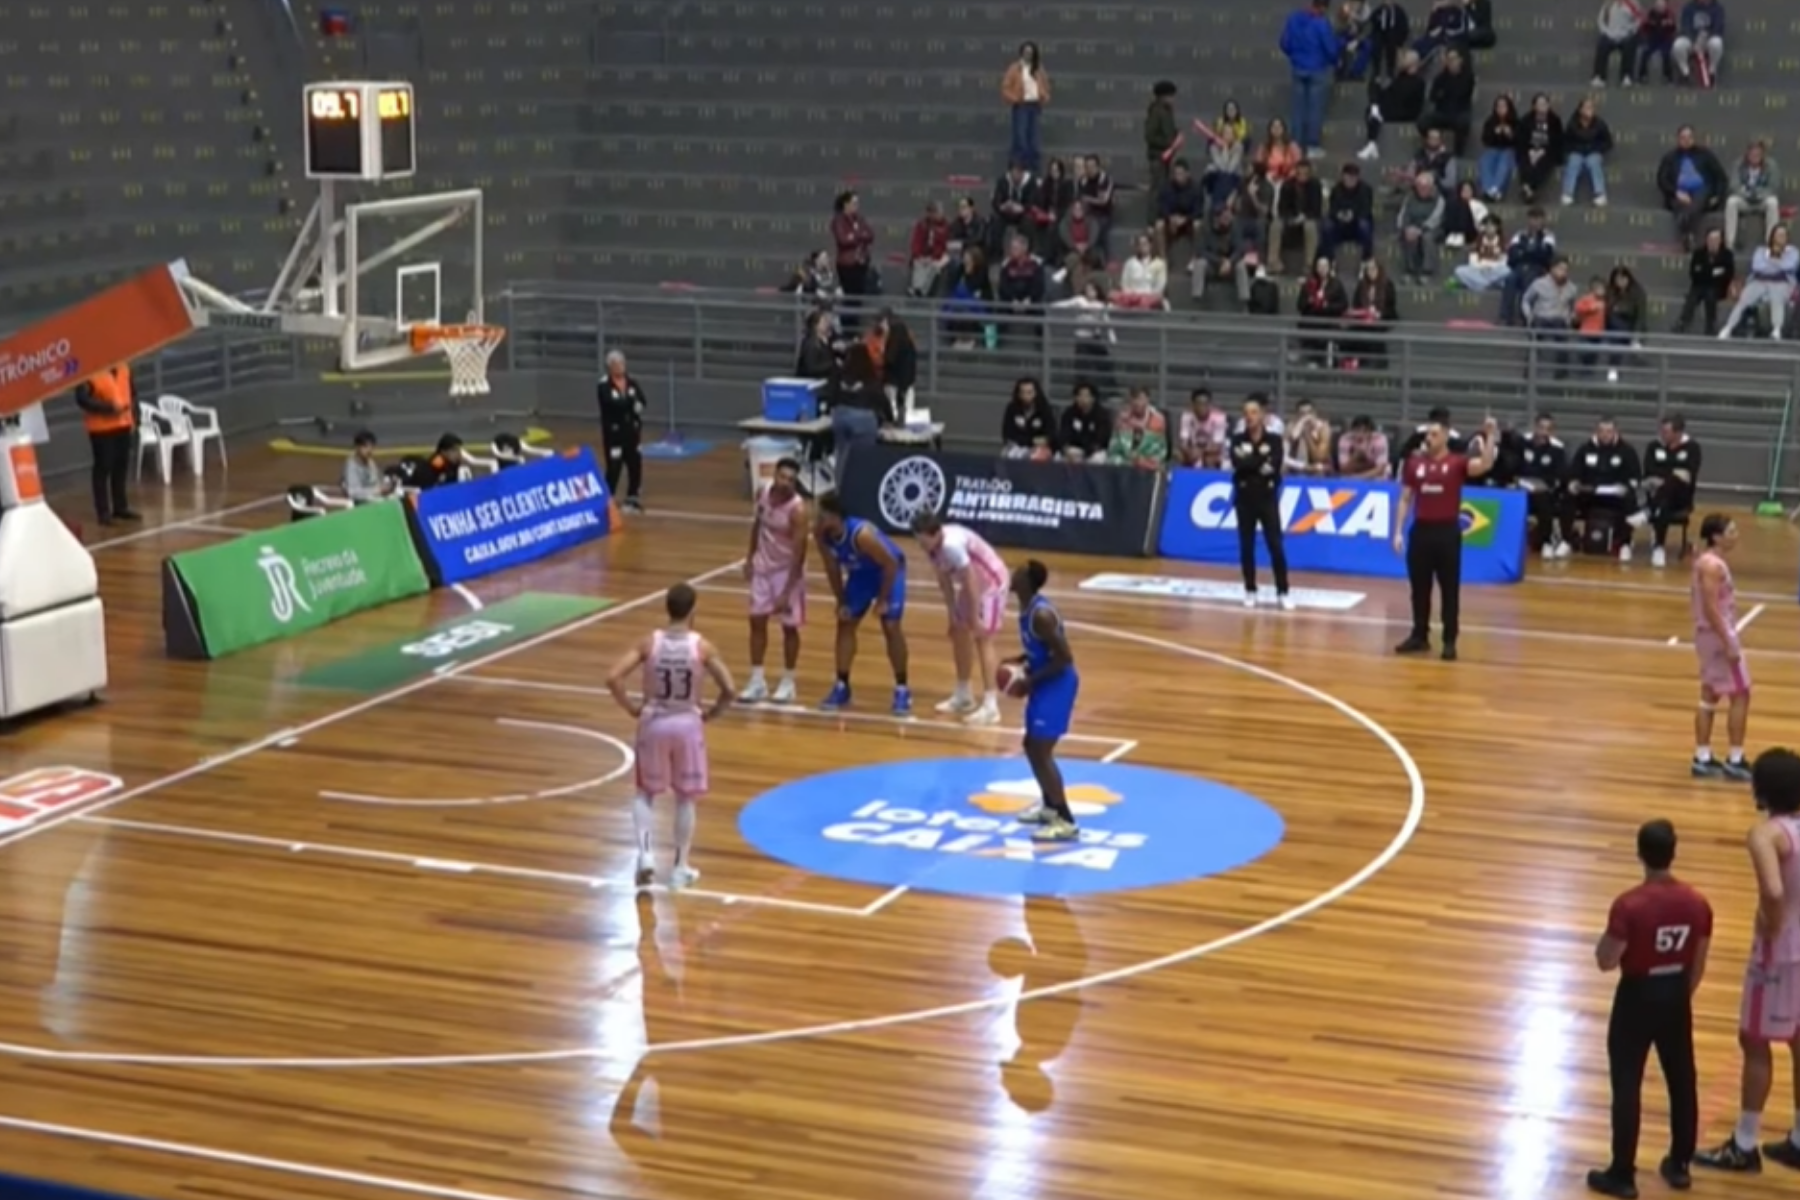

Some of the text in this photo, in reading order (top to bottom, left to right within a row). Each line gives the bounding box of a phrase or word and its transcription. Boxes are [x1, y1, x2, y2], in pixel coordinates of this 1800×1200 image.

[427, 508, 479, 541] VENHA
[475, 499, 504, 531] SER
[546, 471, 603, 507] CAIXA
[949, 489, 1105, 520] ANTIRRACISTA
[1190, 481, 1390, 539] CIXA
[655, 667, 693, 700] 33
[821, 821, 1120, 871] CAIXA
[1655, 924, 1691, 953] 57
